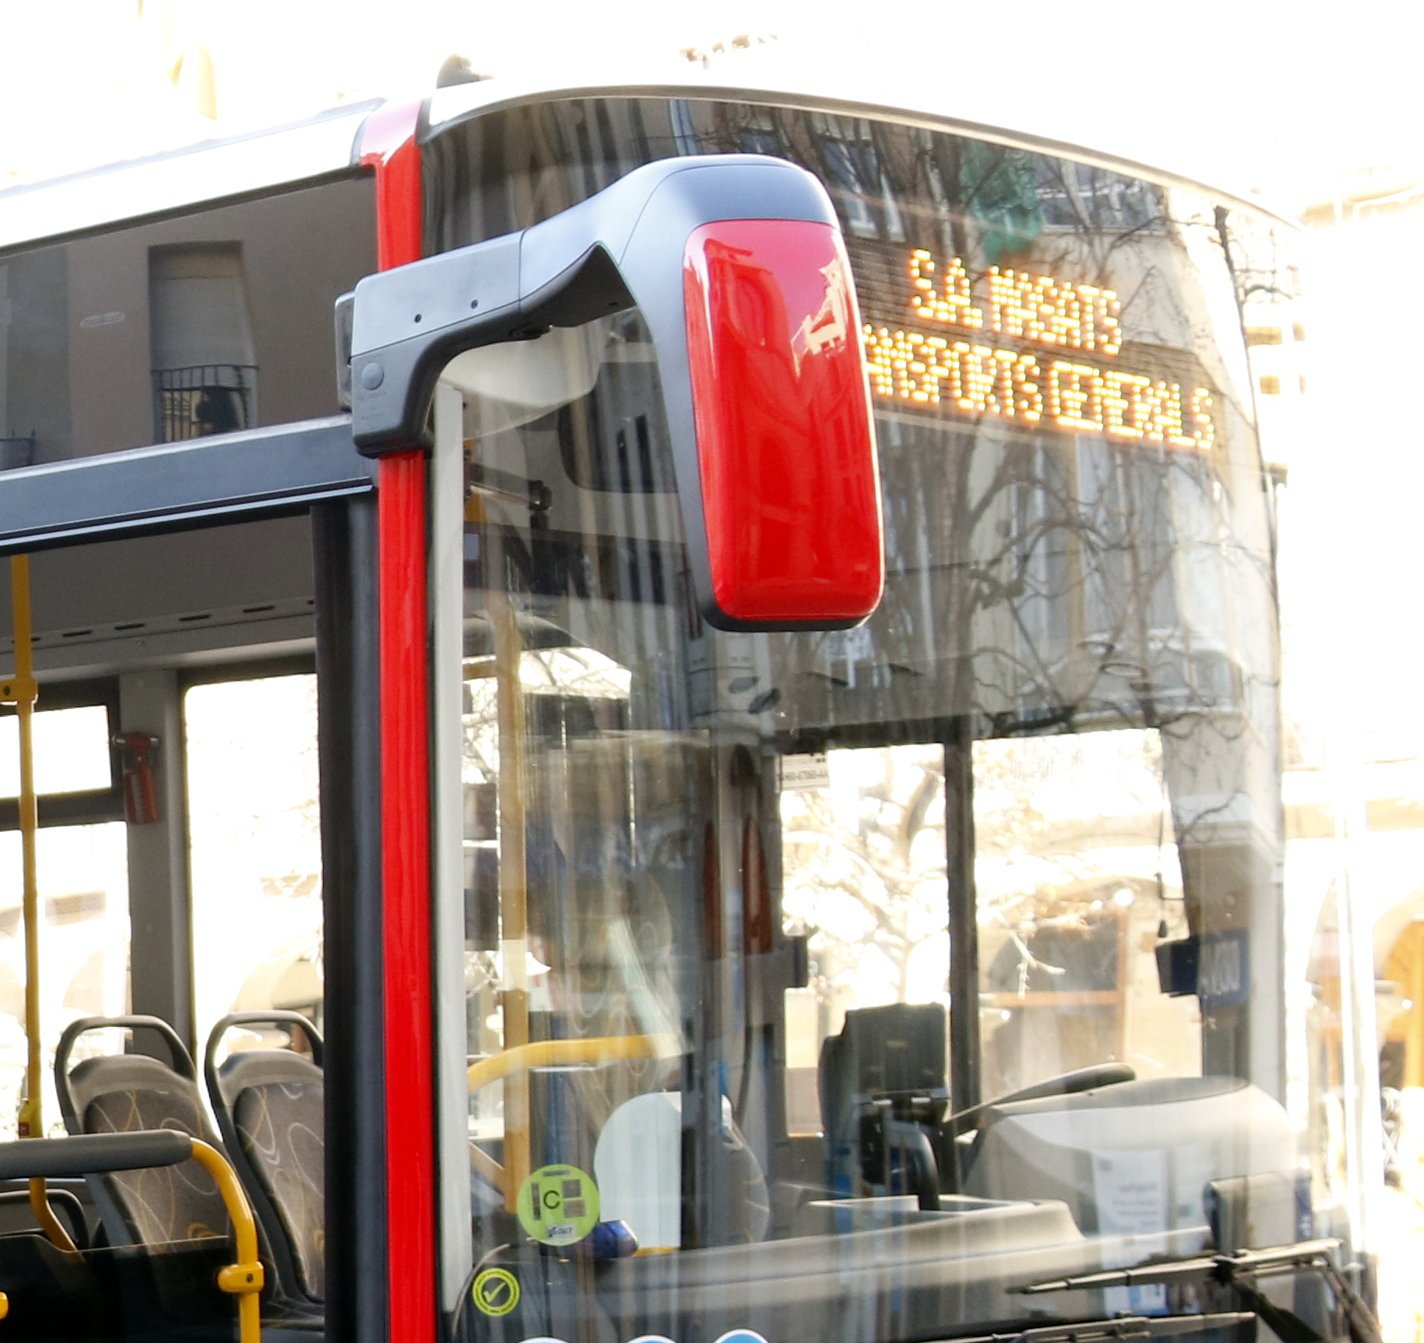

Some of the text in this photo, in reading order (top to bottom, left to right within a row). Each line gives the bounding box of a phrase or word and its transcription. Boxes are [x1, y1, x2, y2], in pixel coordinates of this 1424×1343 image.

[910, 249, 1122, 356] S.A. MASATS
[1051, 359, 1215, 450] GENERALS
[543, 1190, 561, 1210] C
